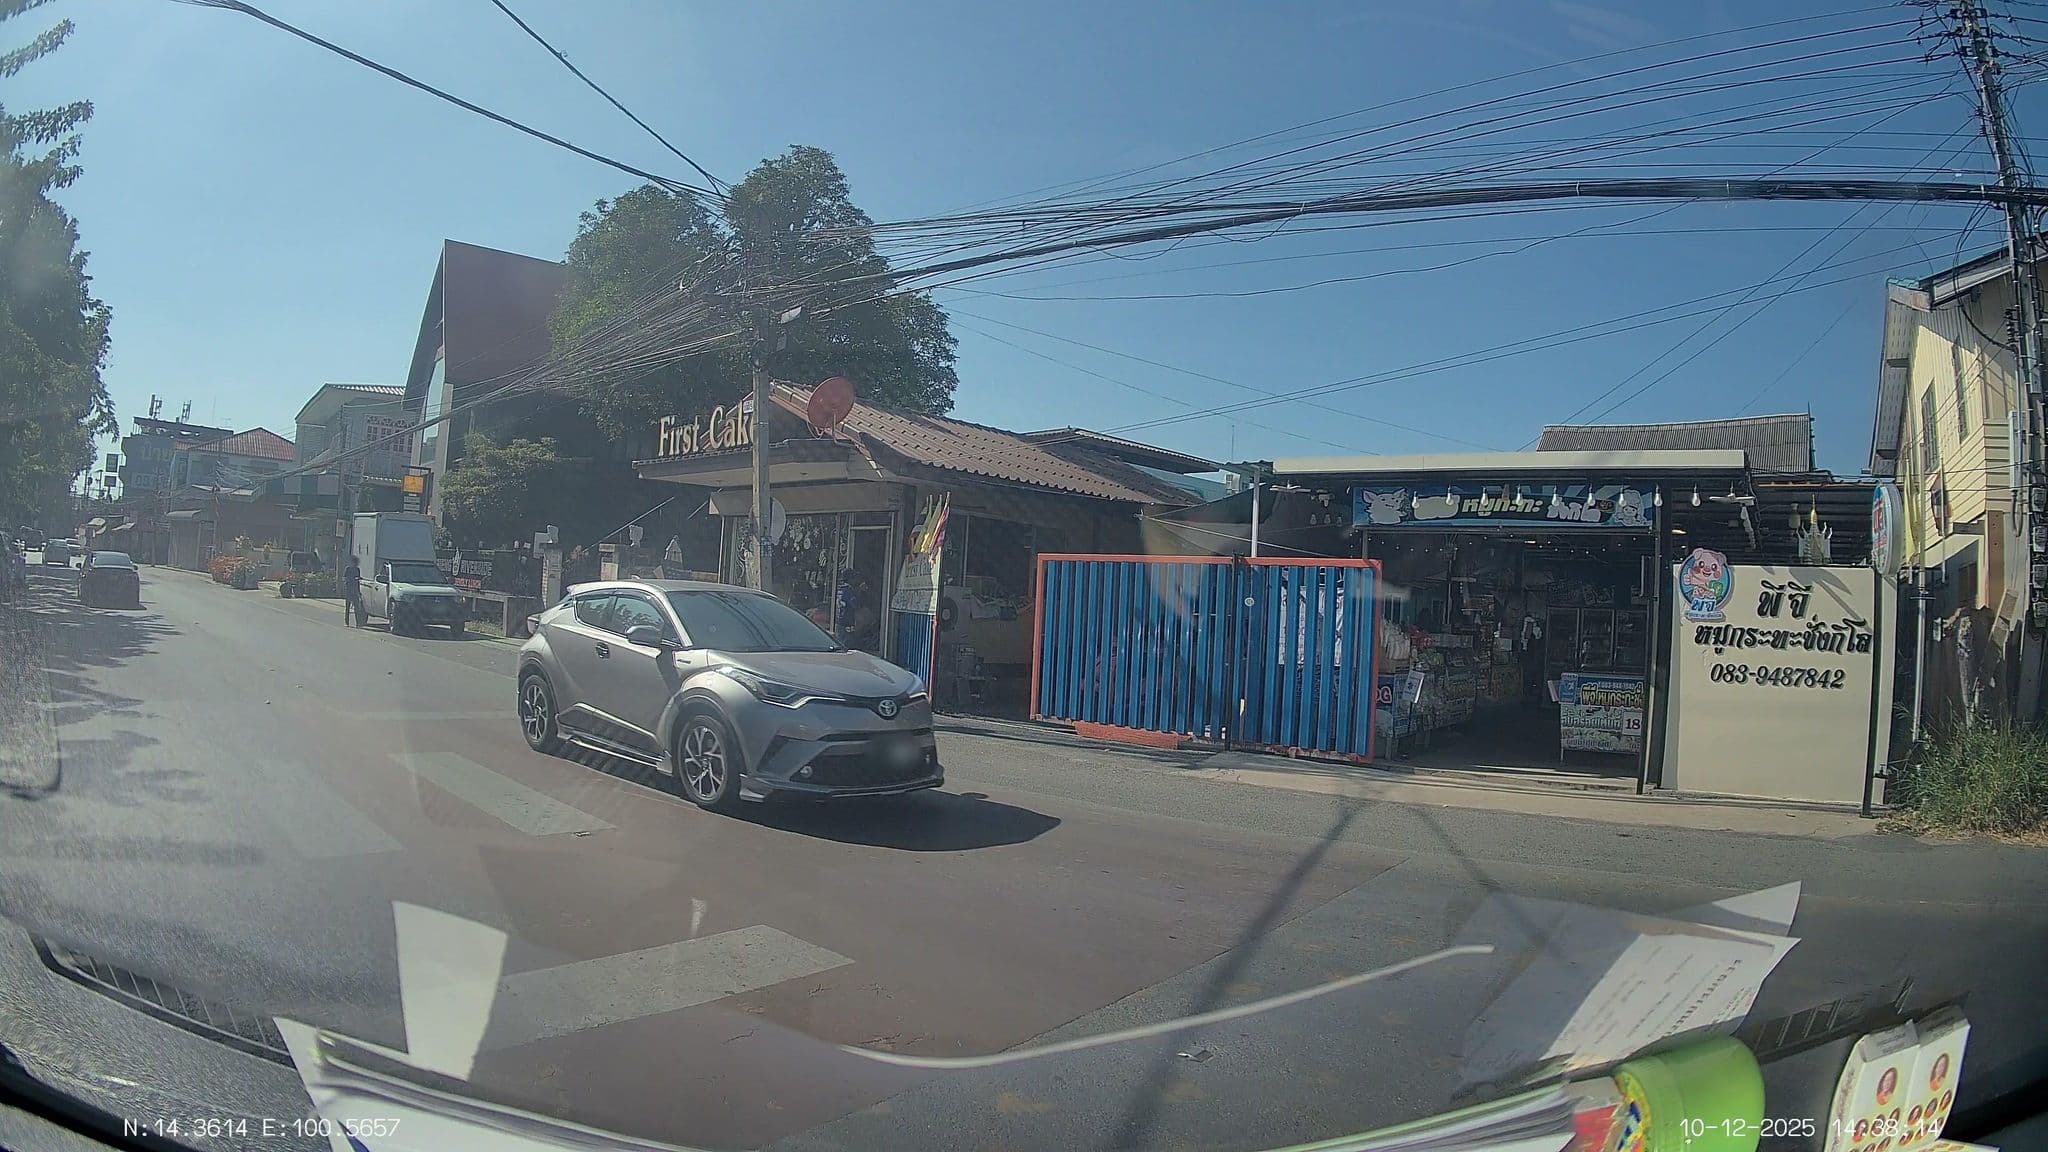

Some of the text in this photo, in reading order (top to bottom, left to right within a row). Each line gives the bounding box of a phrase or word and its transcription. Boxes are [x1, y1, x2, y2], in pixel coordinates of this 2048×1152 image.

[658, 415, 700, 456] First
[1693, 614, 1873, 655] หมูกระทะชั่งกิโล
[1710, 662, 1846, 690] 083-9487842
